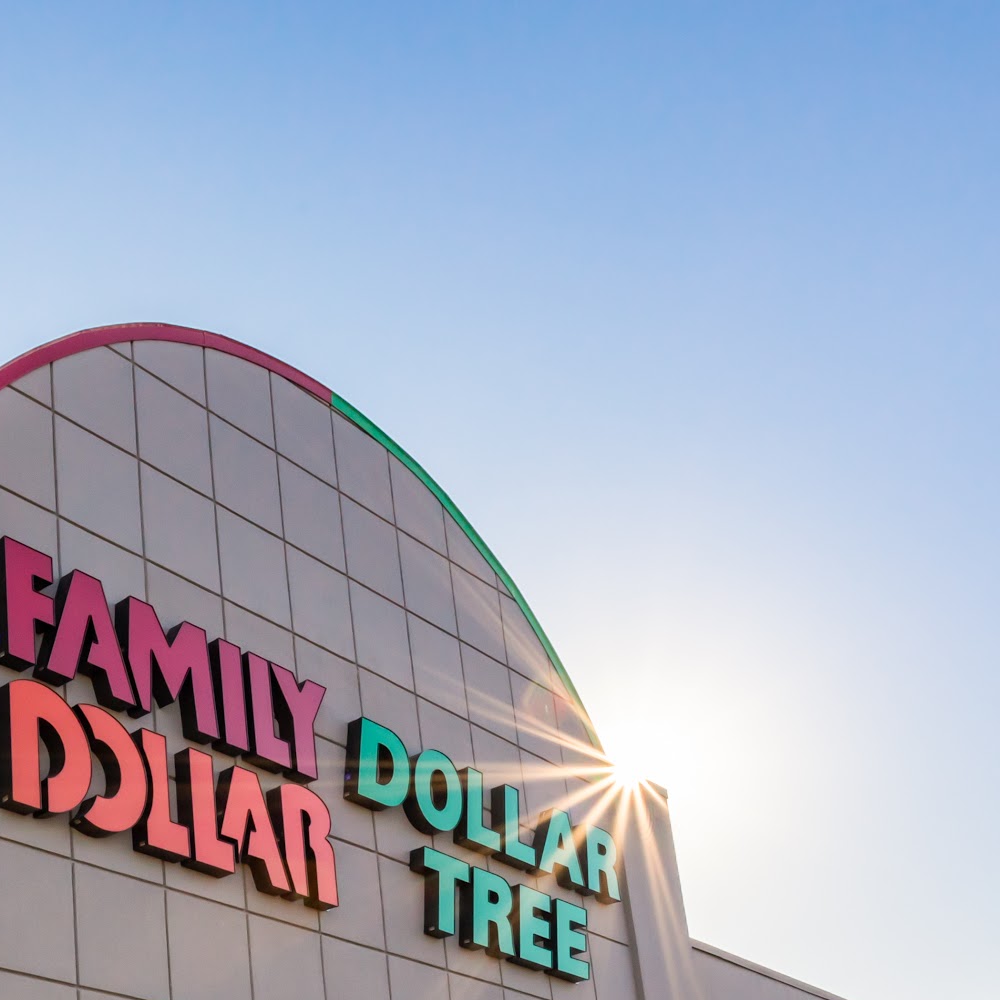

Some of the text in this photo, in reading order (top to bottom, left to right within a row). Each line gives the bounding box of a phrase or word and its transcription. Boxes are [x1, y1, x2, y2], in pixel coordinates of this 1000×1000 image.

[0, 679, 339, 910] DOLLAR
[350, 717, 621, 904] DOLLAR
[414, 846, 591, 983] TREE
